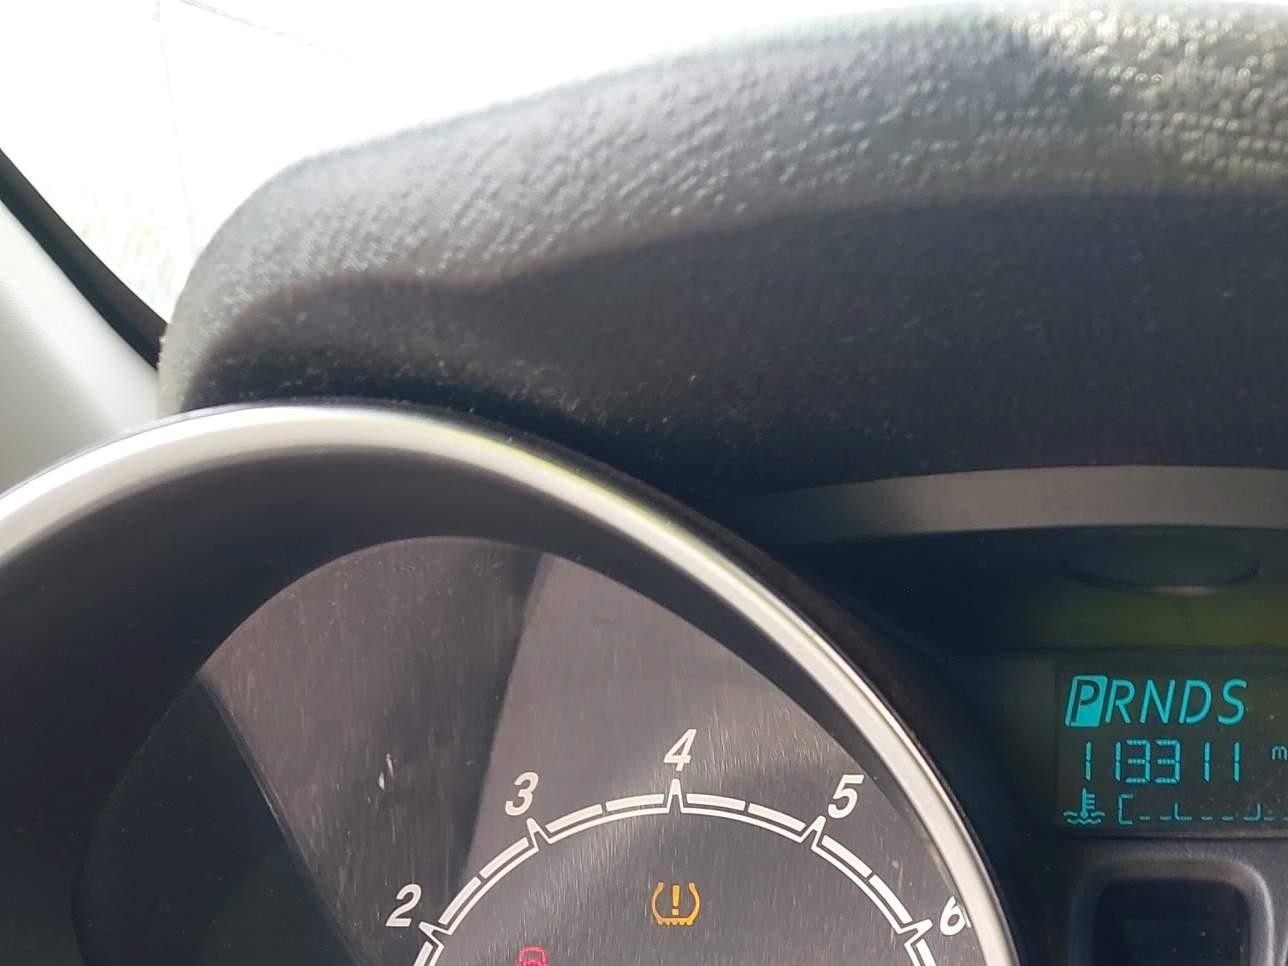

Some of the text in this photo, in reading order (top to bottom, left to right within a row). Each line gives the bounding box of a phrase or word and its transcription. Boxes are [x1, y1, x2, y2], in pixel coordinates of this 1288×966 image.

[664, 730, 697, 771] 4
[1084, 739, 1241, 784] 113311
[505, 772, 539, 816] 3
[828, 775, 864, 819] 5
[386, 884, 421, 927] 2
[940, 896, 967, 936] 6
